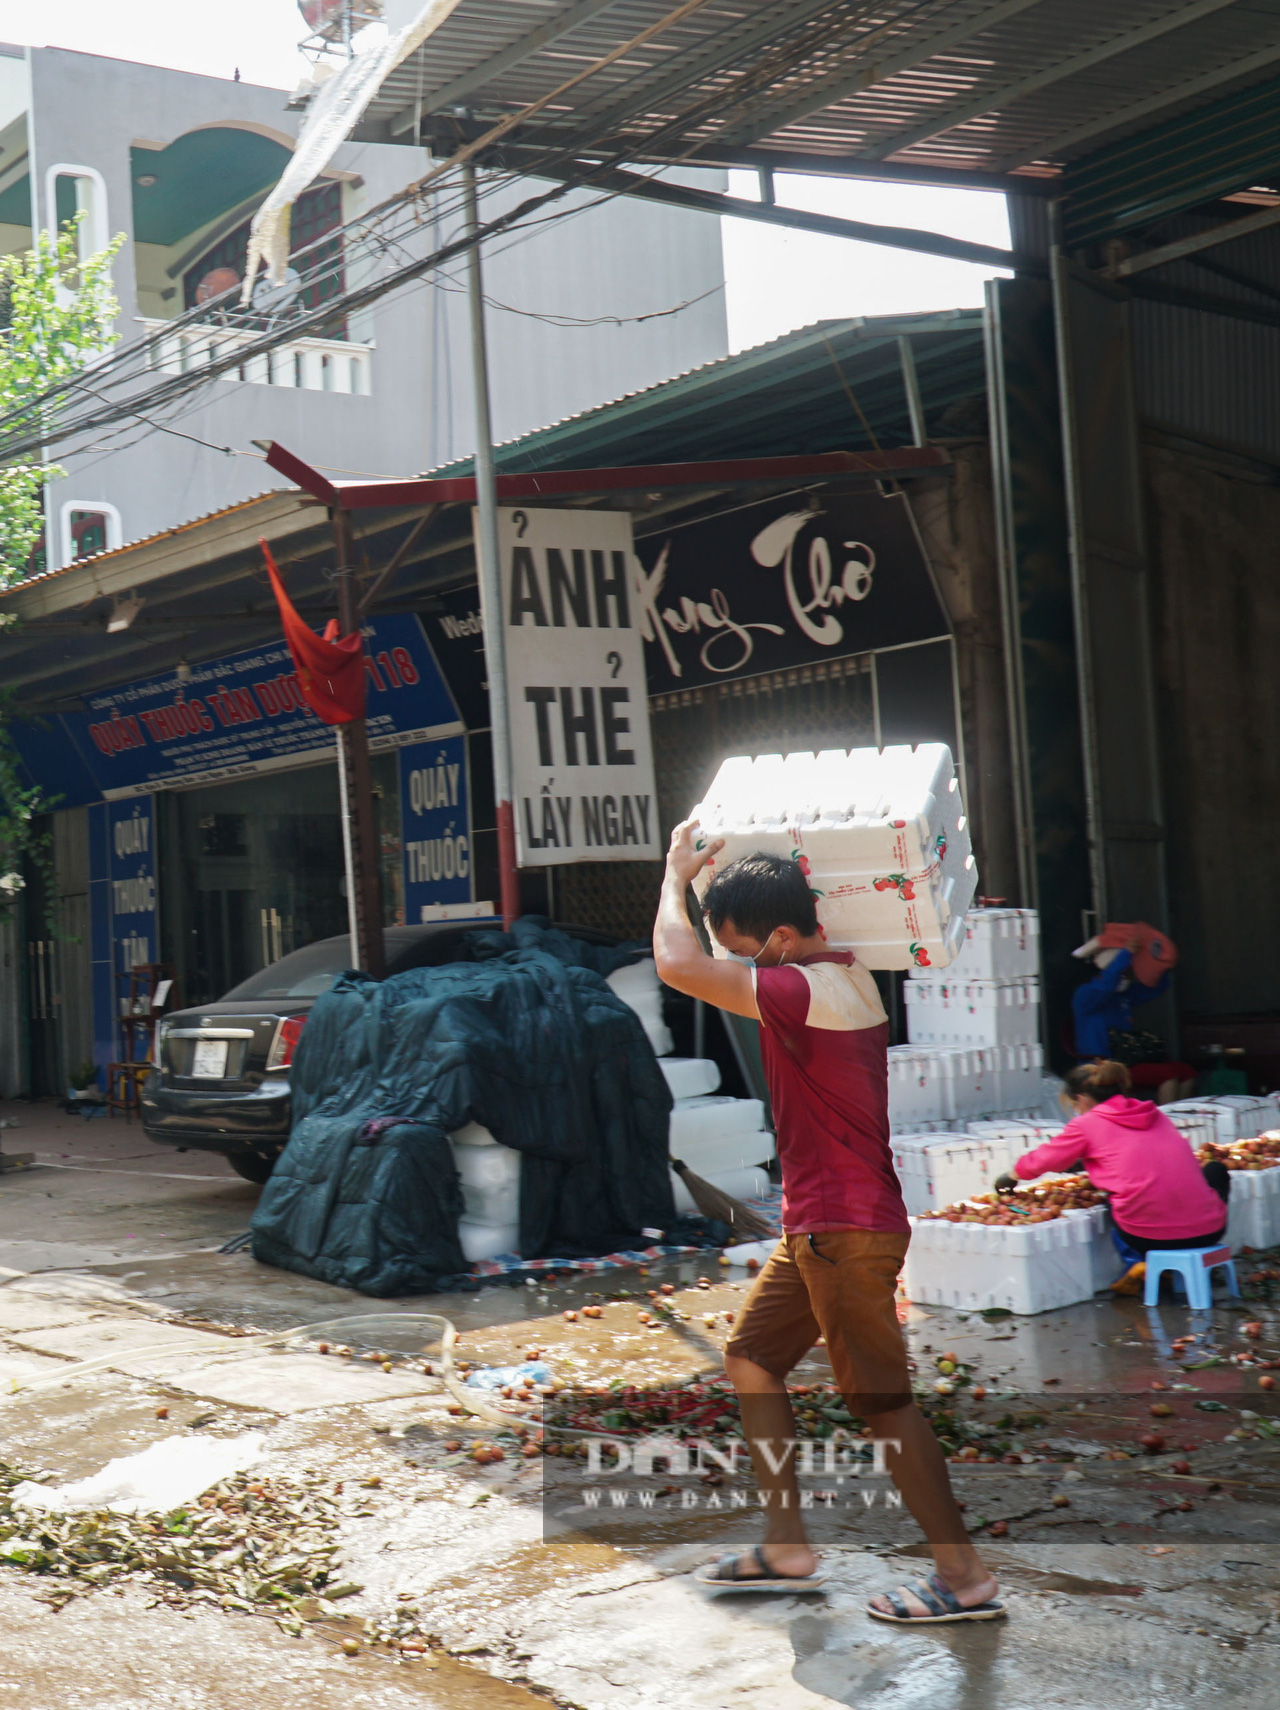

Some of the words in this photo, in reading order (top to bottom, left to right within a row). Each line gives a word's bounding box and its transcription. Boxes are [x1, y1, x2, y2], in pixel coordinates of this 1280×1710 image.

[509, 510, 632, 629] ẢNH
[139, 689, 215, 743] THUỐC
[205, 685, 263, 728] TÂN
[252, 669, 312, 717] DƯỢ
[524, 650, 635, 767] THẺ
[523, 777, 572, 849] LẤY
[580, 794, 651, 847] NGAY
[406, 820, 469, 883] THUỐC
[113, 863, 156, 915] THUỐC
